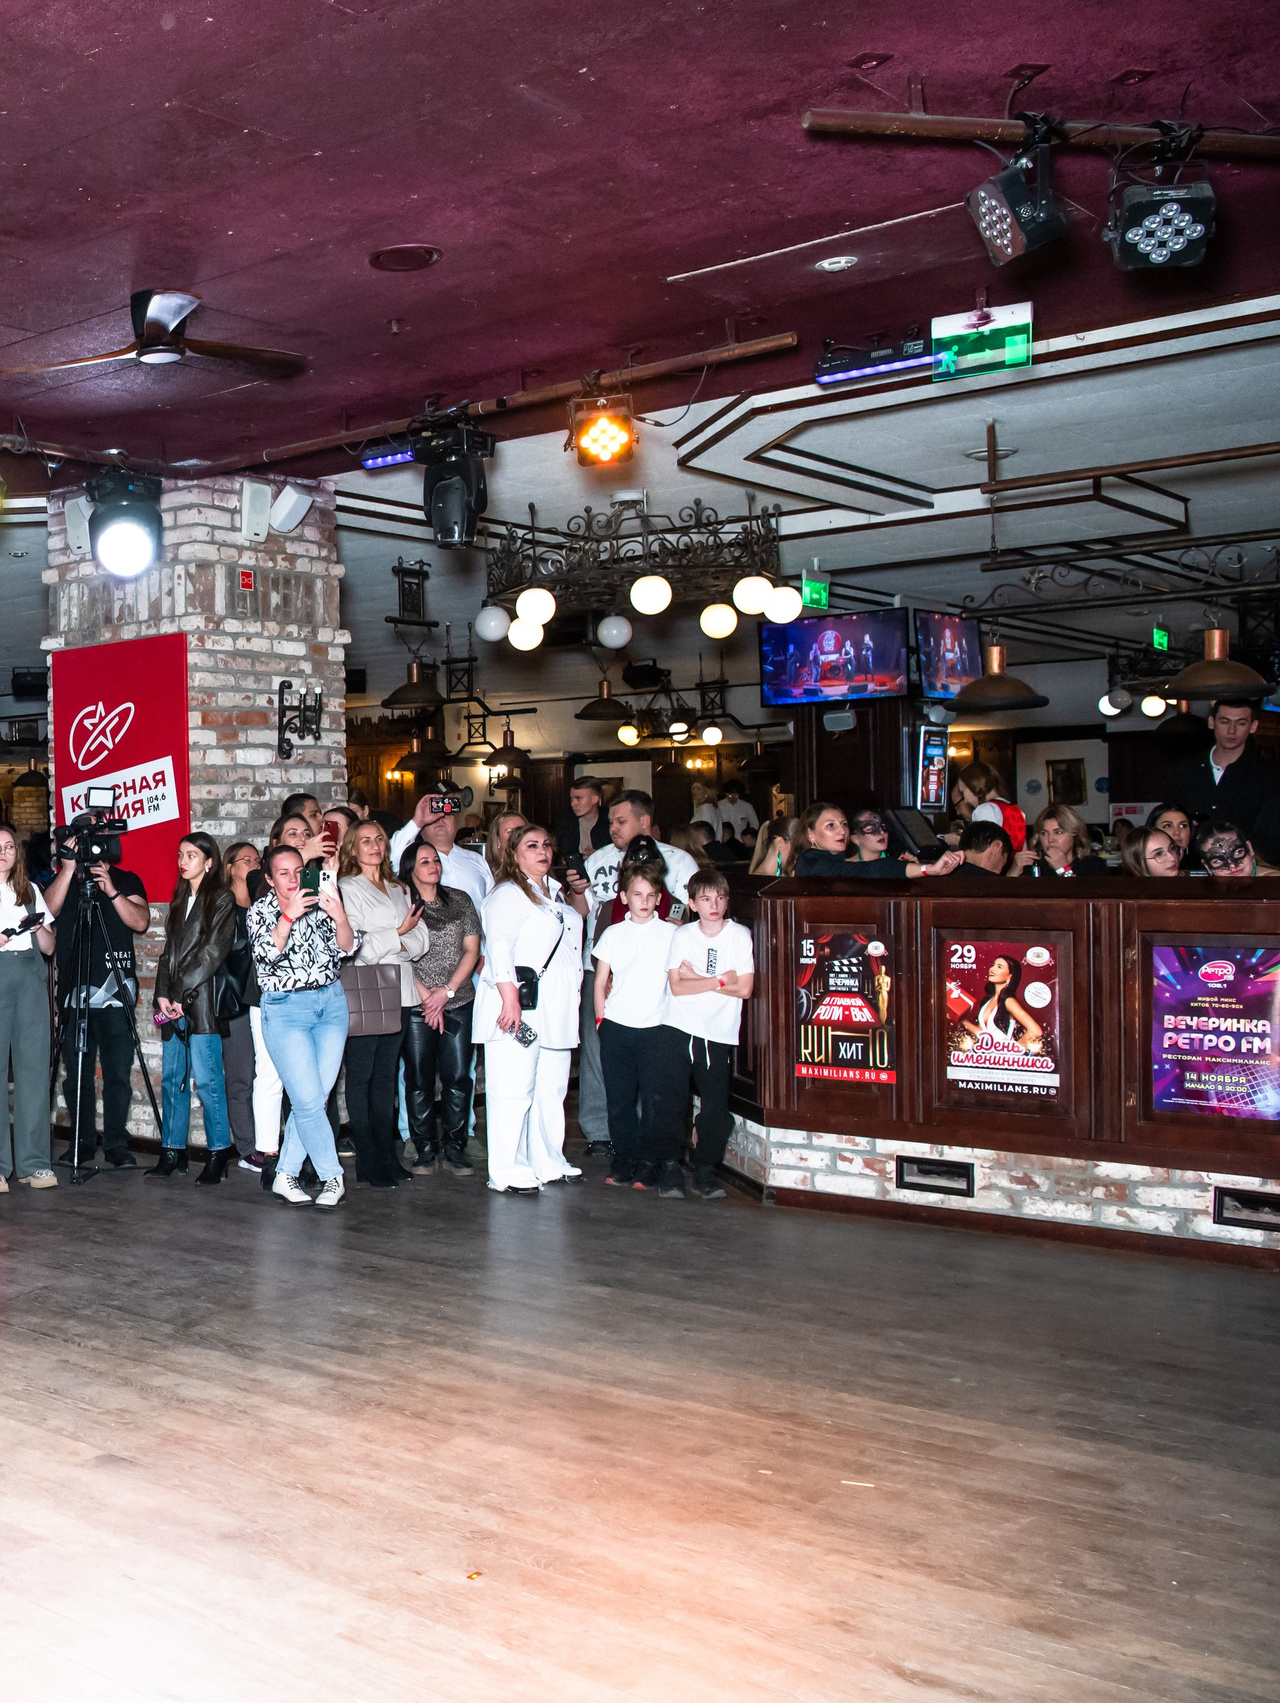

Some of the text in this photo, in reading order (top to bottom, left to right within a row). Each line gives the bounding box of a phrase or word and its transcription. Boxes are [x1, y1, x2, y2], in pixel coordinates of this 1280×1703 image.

[70, 770, 166, 813] КСНАЯ
[147, 792, 167, 805] 104.6
[148, 803, 160, 814] FM
[801, 939, 815, 957] 15
[950, 944, 976, 963] 29
[828, 977, 859, 987] ВЕЧЕРИНКА
[822, 996, 865, 1007] В ГЛАВНОЙ
[812, 1006, 843, 1021] РОЛИ
[850, 1007, 875, 1022] ВЫ!
[1163, 1014, 1271, 1034] ВЕЧЕРИНКА
[975, 1032, 1023, 1054] День
[1163, 1031, 1272, 1054] РЕТРО FM
[838, 1042, 864, 1060] ХИТ
[951, 1052, 1055, 1070] именинника
[1162, 1053, 1271, 1066] РЕСТОРАН МАКСИМИЛИАНС
[801, 1066, 876, 1080] MAXIMILIANS.RU
[1185, 1072, 1247, 1084] 14 НОЯБРЯ
[958, 1081, 1047, 1095] MAXIMILIANS.RU
